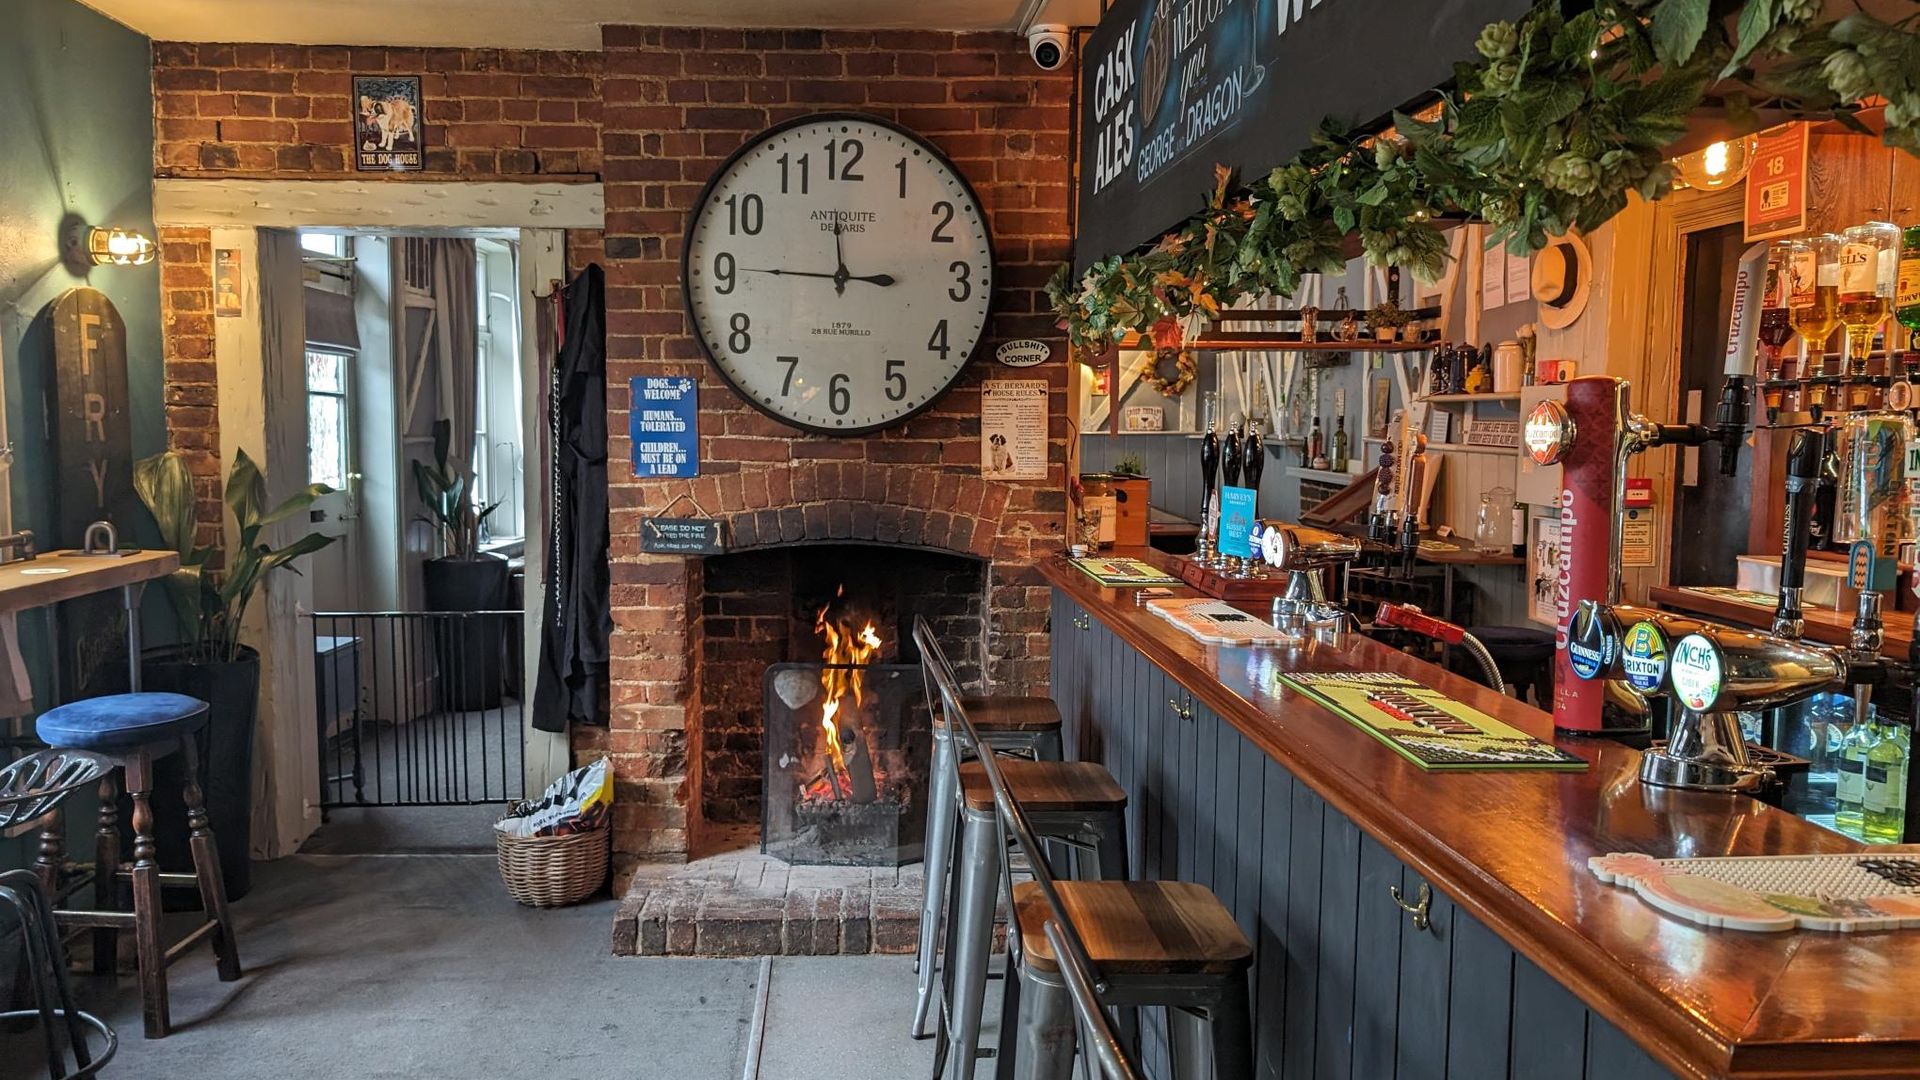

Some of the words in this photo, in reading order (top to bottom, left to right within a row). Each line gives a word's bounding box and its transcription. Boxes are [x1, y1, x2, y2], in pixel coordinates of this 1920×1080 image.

[1094, 19, 1137, 124] CASK
[1180, 43, 1208, 123] you
[1138, 122, 1175, 183] GEORGE
[1186, 65, 1243, 147] DRAGON
[361, 153, 376, 165] THE
[378, 153, 393, 165] DOG
[395, 153, 418, 165] HOUSE
[823, 139, 864, 181] 12
[1093, 100, 1135, 195] ALES
[776, 153, 809, 194] 11
[895, 157, 907, 199] 1
[1766, 156, 1785, 177] 18
[724, 193, 764, 236] 10
[810, 210, 876, 222] ANTIQUITE
[820, 223, 833, 232] DE
[931, 201, 954, 243] 2
[714, 252, 736, 295] 9
[948, 261, 972, 302] 3
[728, 313, 751, 354] 8
[831, 321, 852, 329] 1879
[927, 319, 951, 360] 4
[1001, 342, 1046, 354] BULLSHIT
[1004, 354, 1041, 363] CORNER
[643, 389, 681, 400] WELCOME
[647, 378, 677, 389] DOGS...
[776, 356, 799, 397] 7
[884, 360, 907, 401] 5
[828, 374, 851, 416] 6
[640, 422, 686, 432] TOLERATED
[643, 410, 682, 421] HUMANS...
[640, 442, 687, 453] CHILDREN...
[641, 453, 660, 464] MUST
[663, 453, 674, 464] BE
[675, 454, 687, 464] ON
[650, 464, 656, 475] A
[657, 464, 678, 475] LEAD
[1782, 504, 1792, 555] GUINNESS
[1570, 641, 1600, 661] GUINNESS
[1604, 634, 1613, 665] GUINNESS
[1623, 659, 1660, 675] BRIXTON
